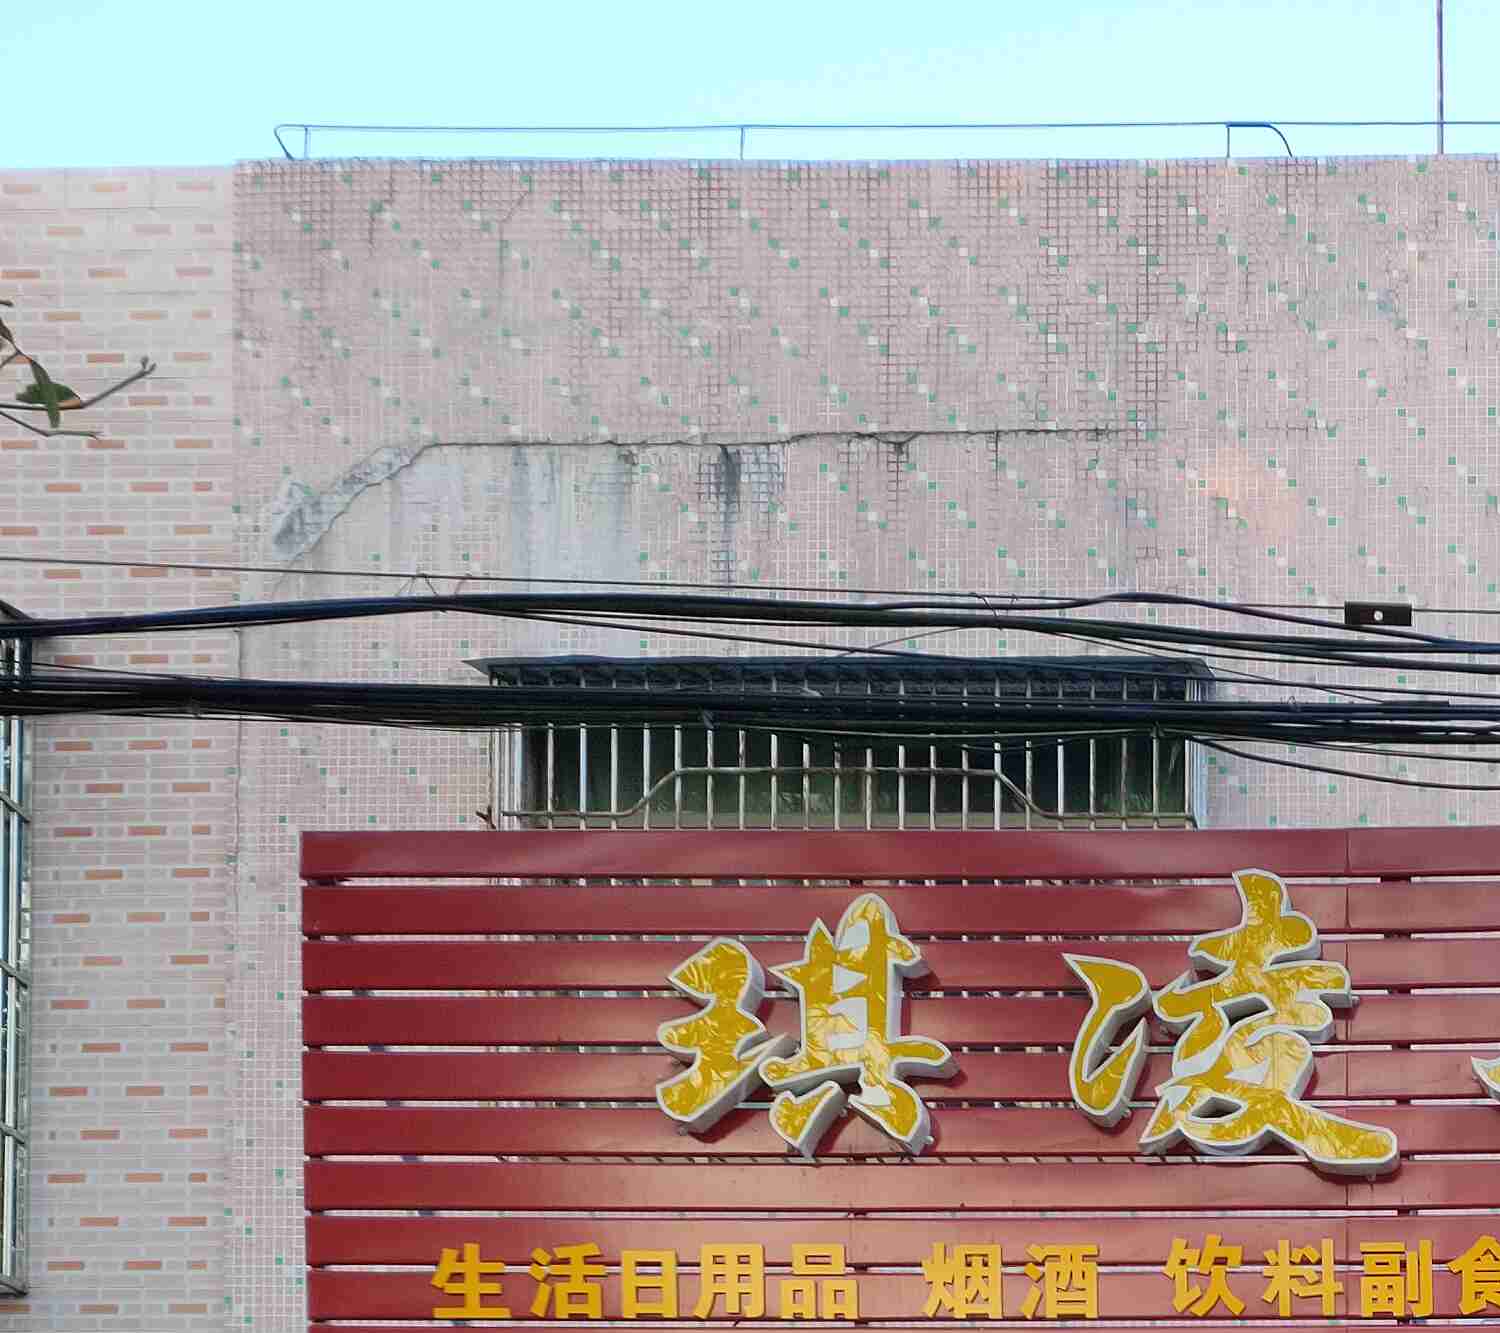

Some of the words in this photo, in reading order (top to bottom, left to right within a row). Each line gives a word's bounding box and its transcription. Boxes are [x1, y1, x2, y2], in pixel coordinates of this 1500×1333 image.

[431, 1240, 860, 1321] 生活日用品
[923, 1240, 1102, 1321] 烟酒
